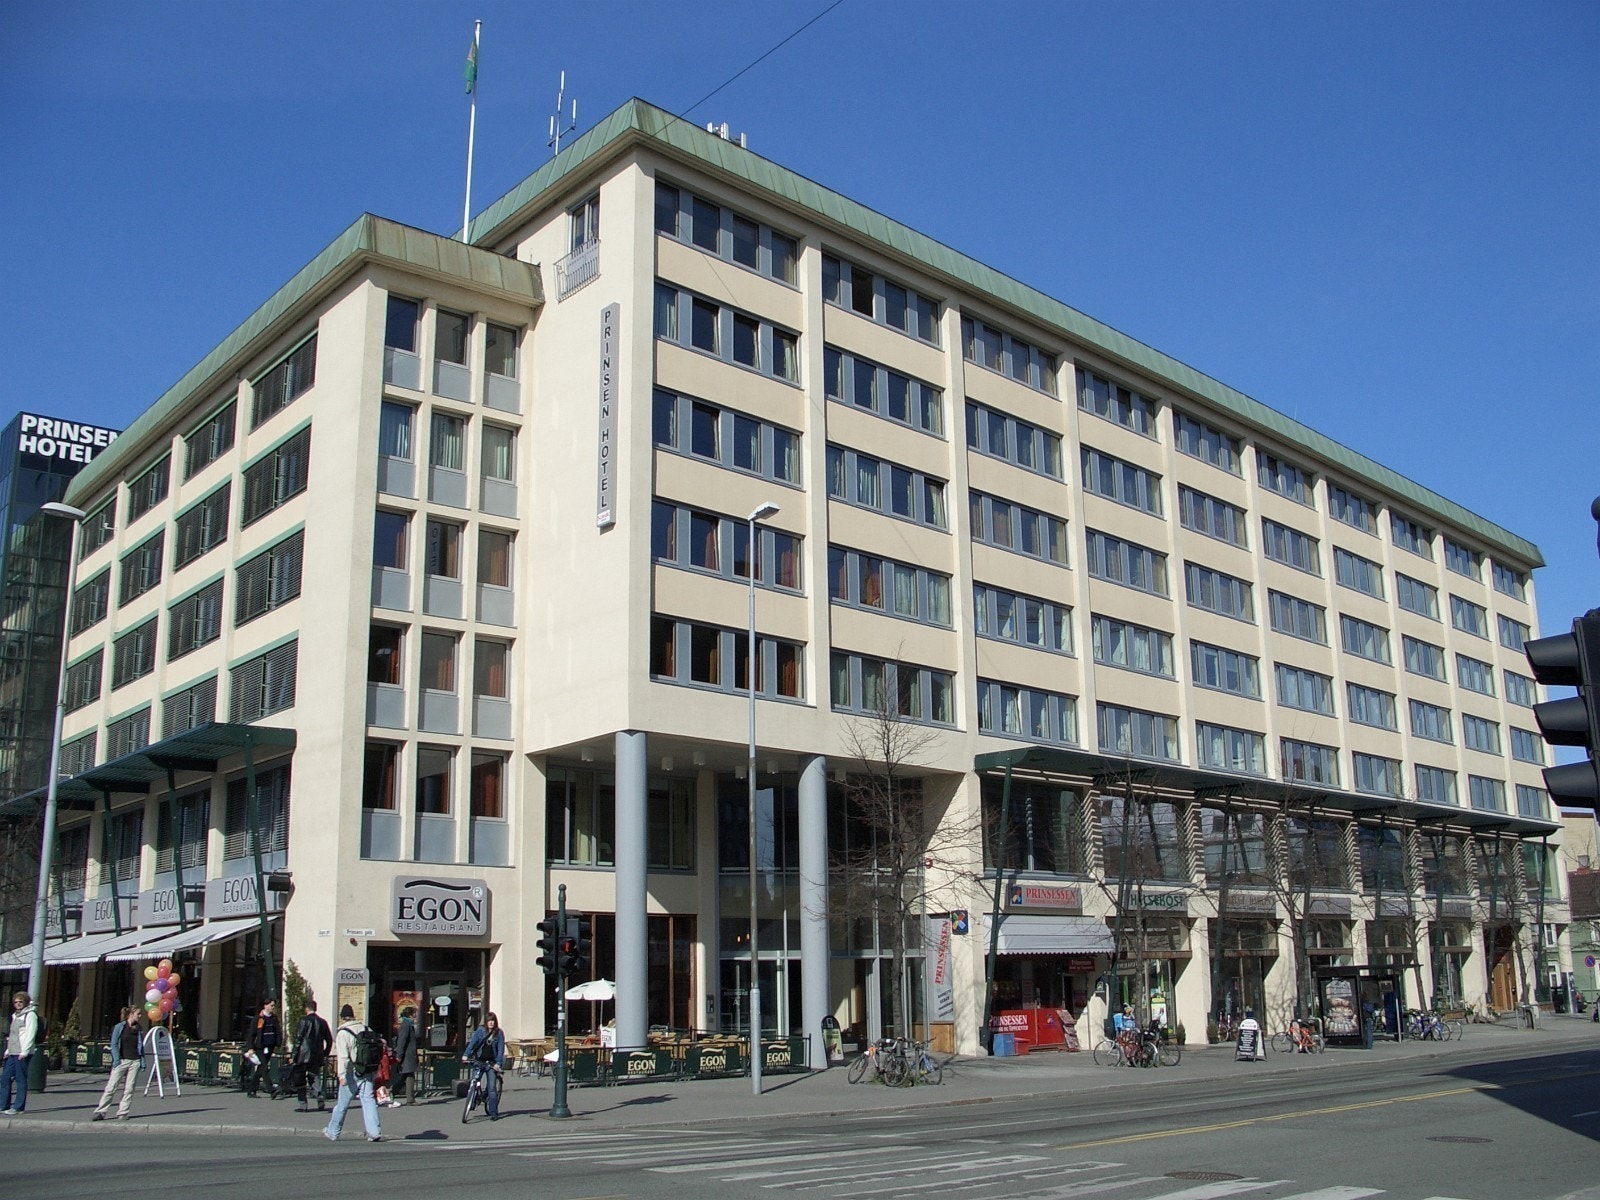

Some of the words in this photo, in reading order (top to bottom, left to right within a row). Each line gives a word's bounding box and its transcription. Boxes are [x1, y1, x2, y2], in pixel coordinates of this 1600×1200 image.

[602, 310, 611, 419] PRINSEN
[19, 434, 93, 464] HOTEL
[601, 428, 610, 508] HOTEL
[1026, 887, 1076, 899] PRINSESSEN
[153, 889, 177, 912] EGO
[1130, 894, 1184, 907] HLSEKOST
[95, 900, 115, 920] EGO
[398, 896, 482, 922] EGON
[397, 922, 481, 931] RESTAURANT
[935, 920, 949, 985] PRINSESSEN
[341, 972, 364, 980] EGON
[700, 1055, 726, 1067] EGON
[766, 1051, 791, 1063] EGON
[218, 1061, 233, 1073] EGON
[627, 1060, 656, 1071] EGON
